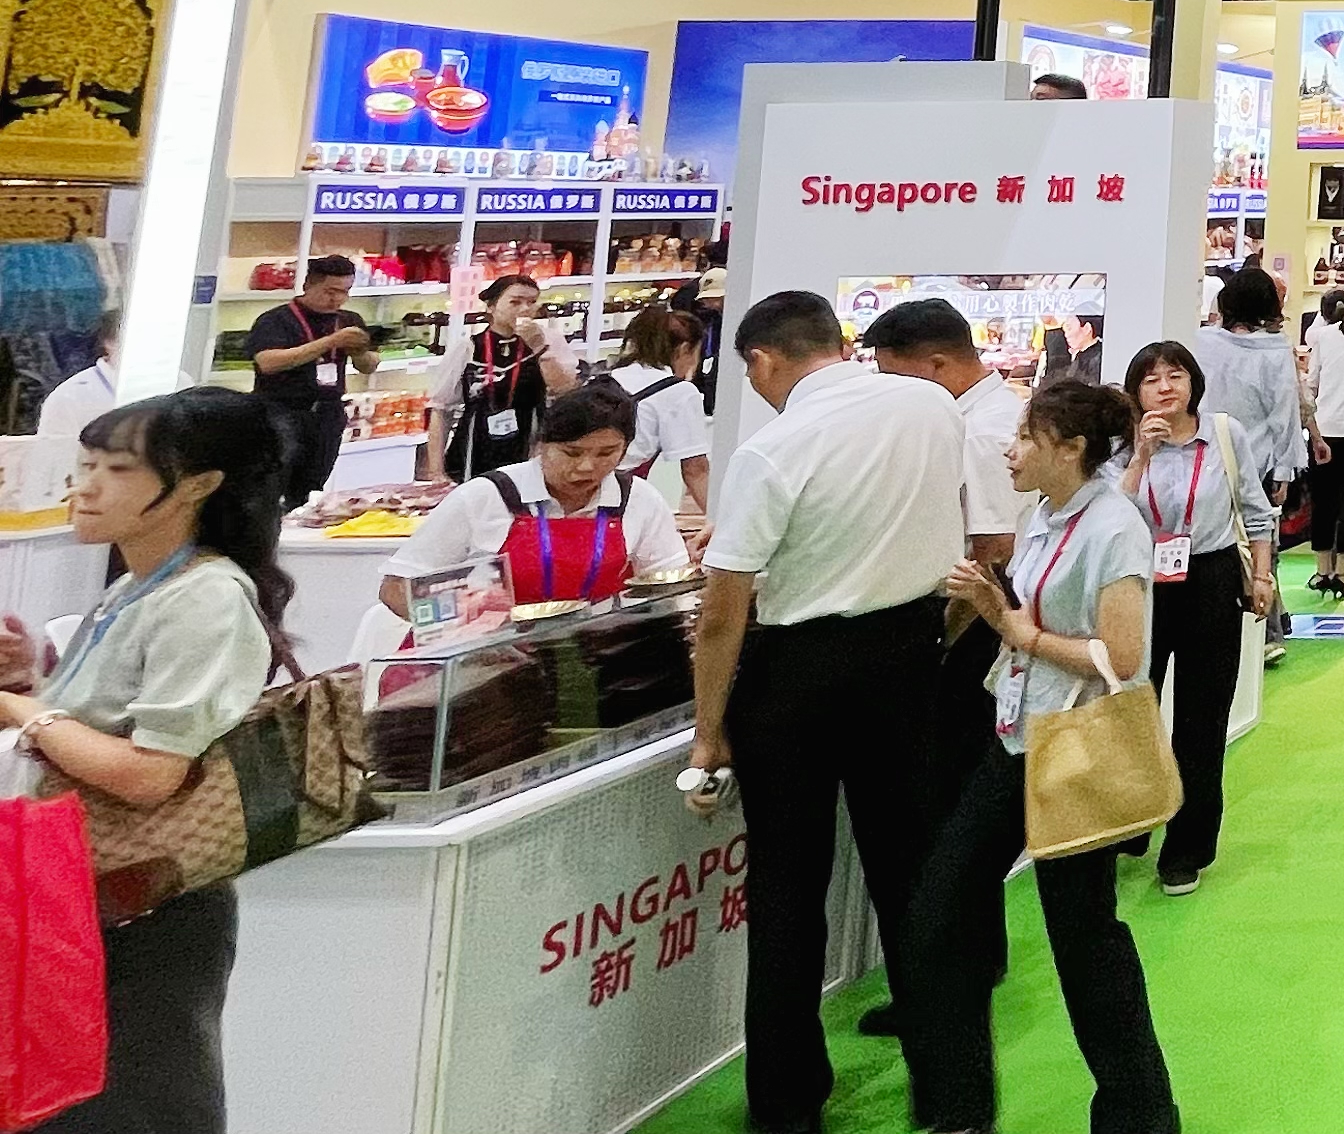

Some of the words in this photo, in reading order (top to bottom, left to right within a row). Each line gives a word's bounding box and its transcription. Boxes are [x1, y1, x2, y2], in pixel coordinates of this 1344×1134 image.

[320, 191, 399, 210] RUSSIA
[479, 193, 546, 210] RUSSIA
[614, 193, 671, 210] RUSSIA
[801, 176, 978, 212] Singapore
[996, 173, 1125, 202] 新加坡
